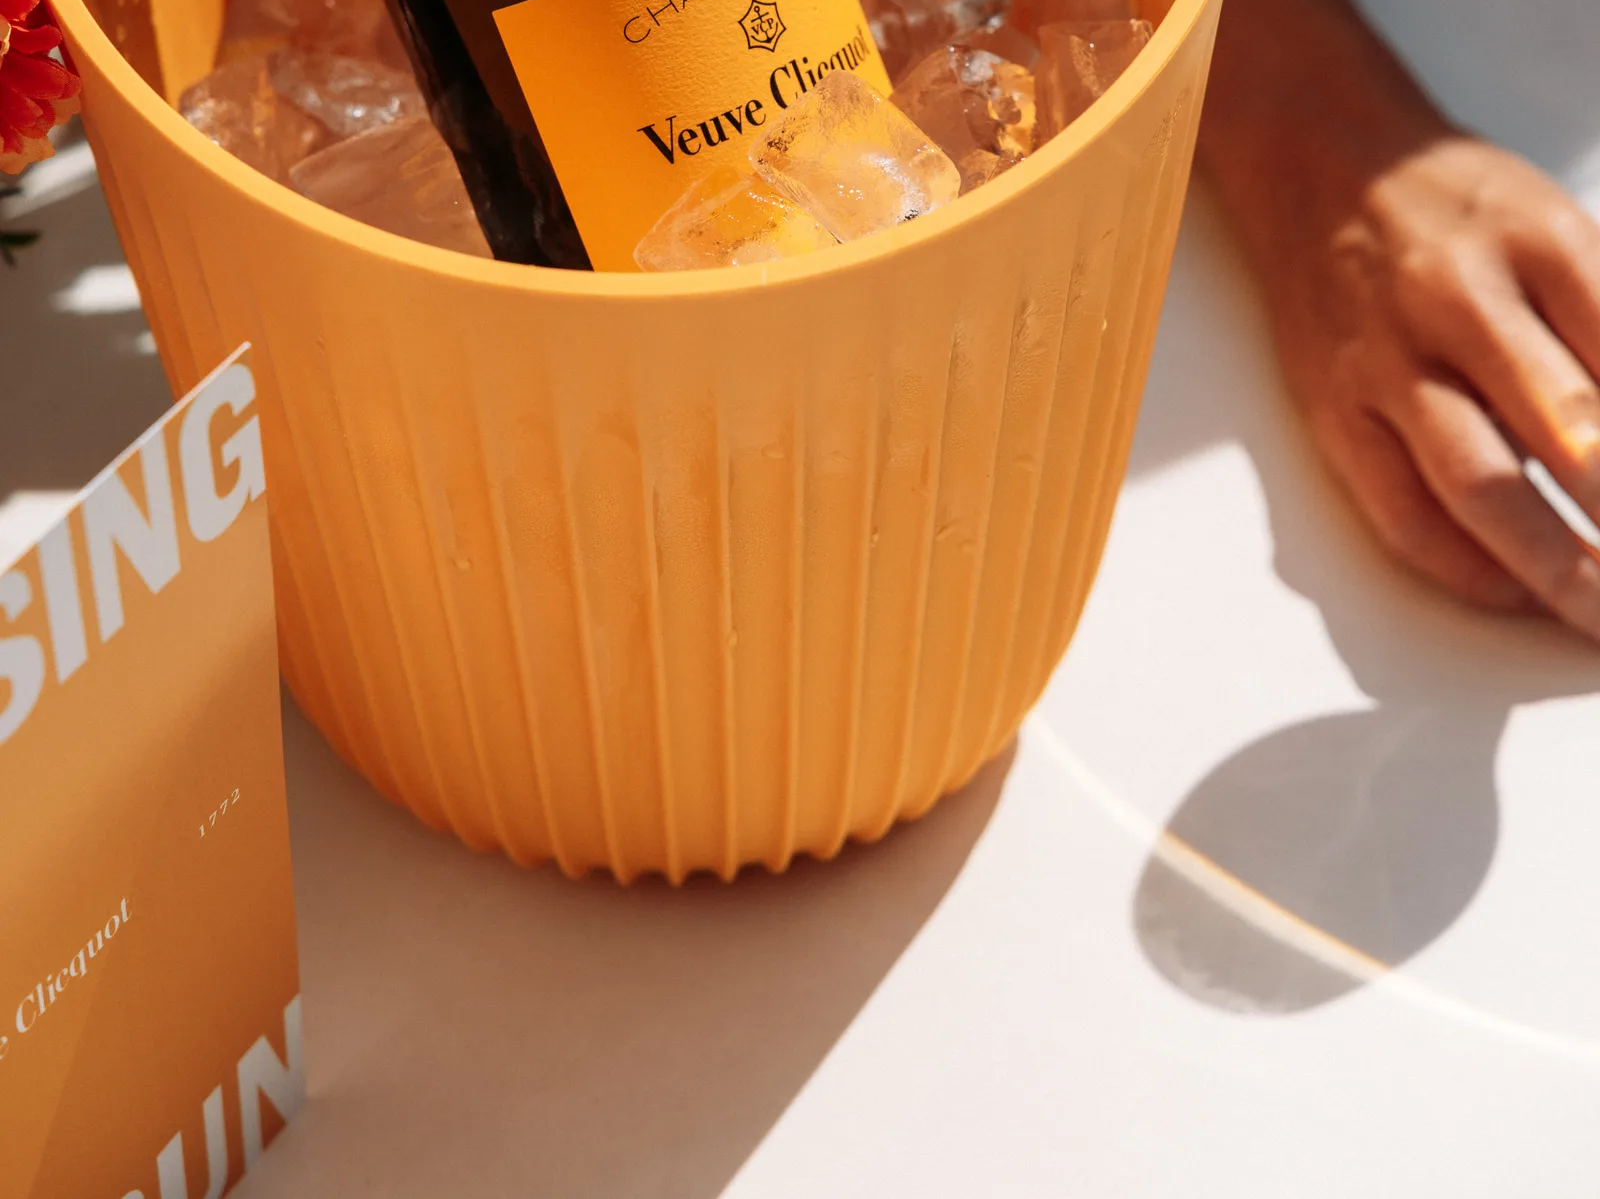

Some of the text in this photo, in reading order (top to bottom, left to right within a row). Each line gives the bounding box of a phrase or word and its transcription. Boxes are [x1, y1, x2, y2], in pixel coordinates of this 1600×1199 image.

[637, 99, 767, 165] Veuve
[199, 788, 240, 838] 1772
[16, 897, 132, 1033] Clicquot
[120, 993, 303, 1199] UN
